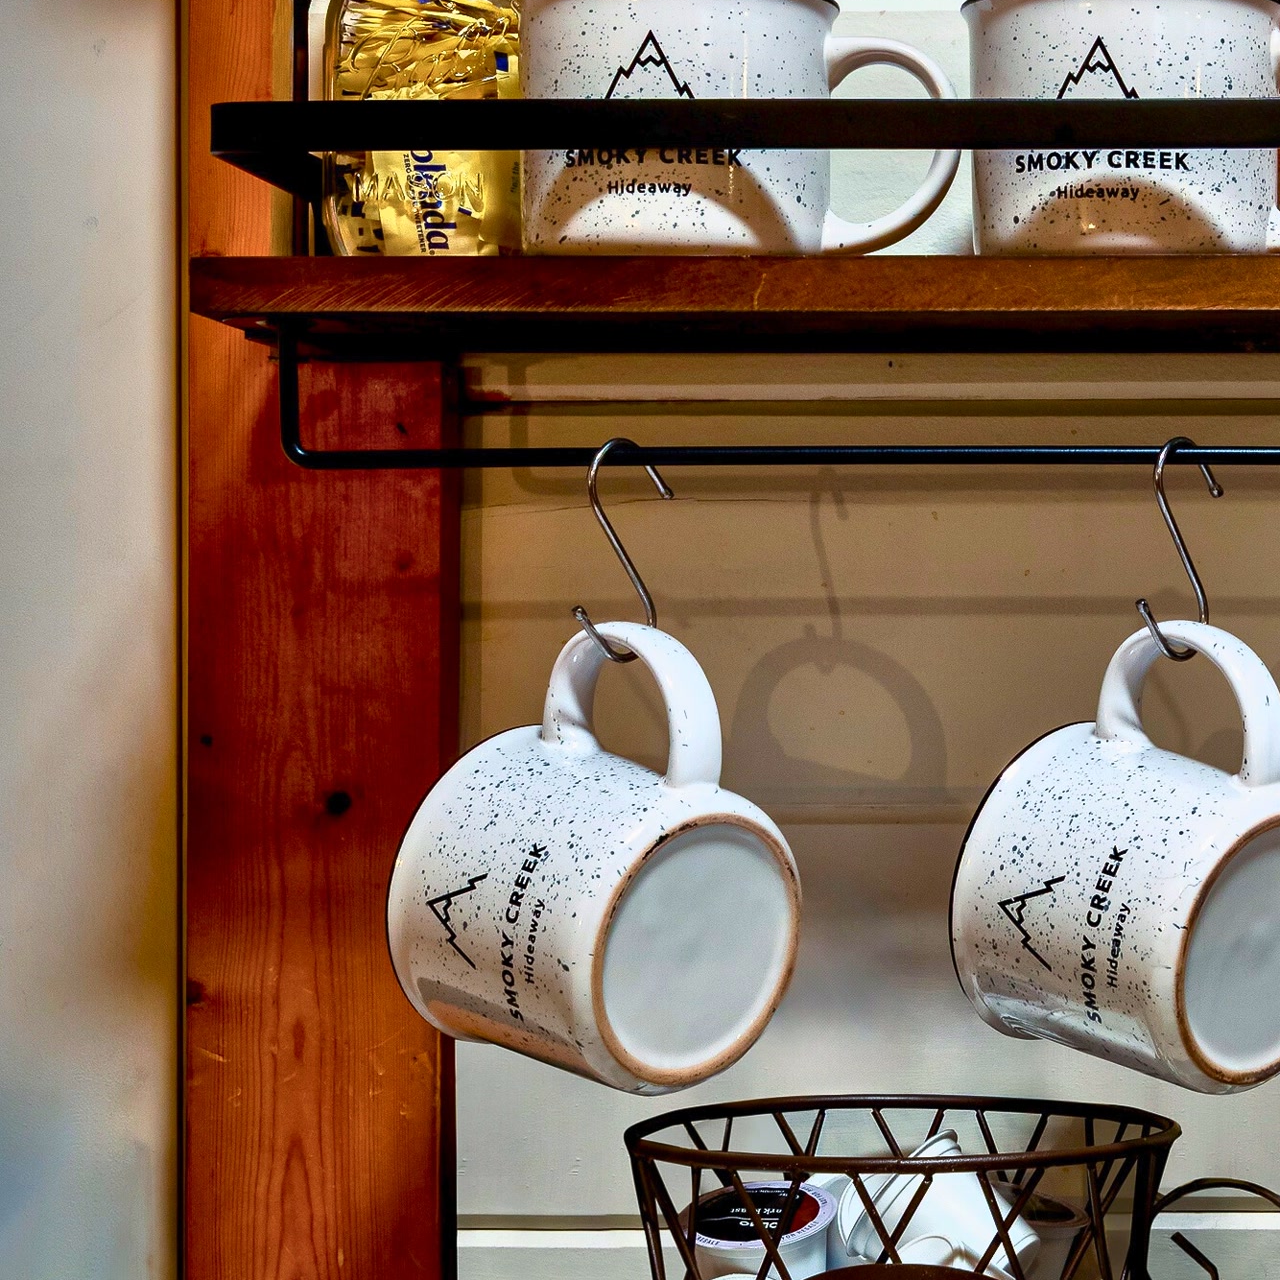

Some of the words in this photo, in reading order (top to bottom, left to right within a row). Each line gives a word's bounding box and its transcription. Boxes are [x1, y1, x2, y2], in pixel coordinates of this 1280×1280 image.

[565, 149, 646, 168] SMOKY
[659, 149, 742, 167] CREEK
[607, 180, 692, 196] Hideaway
[1015, 151, 1098, 173] SMOKY
[1107, 150, 1192, 171] CREEK
[1056, 184, 1139, 201] Hideaway
[506, 843, 548, 924] CREEK
[1087, 845, 1129, 928] CREEK
[500, 930, 524, 1022] SMOKY
[524, 898, 546, 984] Hideaway
[1080, 934, 1102, 1024] SMOKY
[1106, 903, 1131, 988] Hideaway
